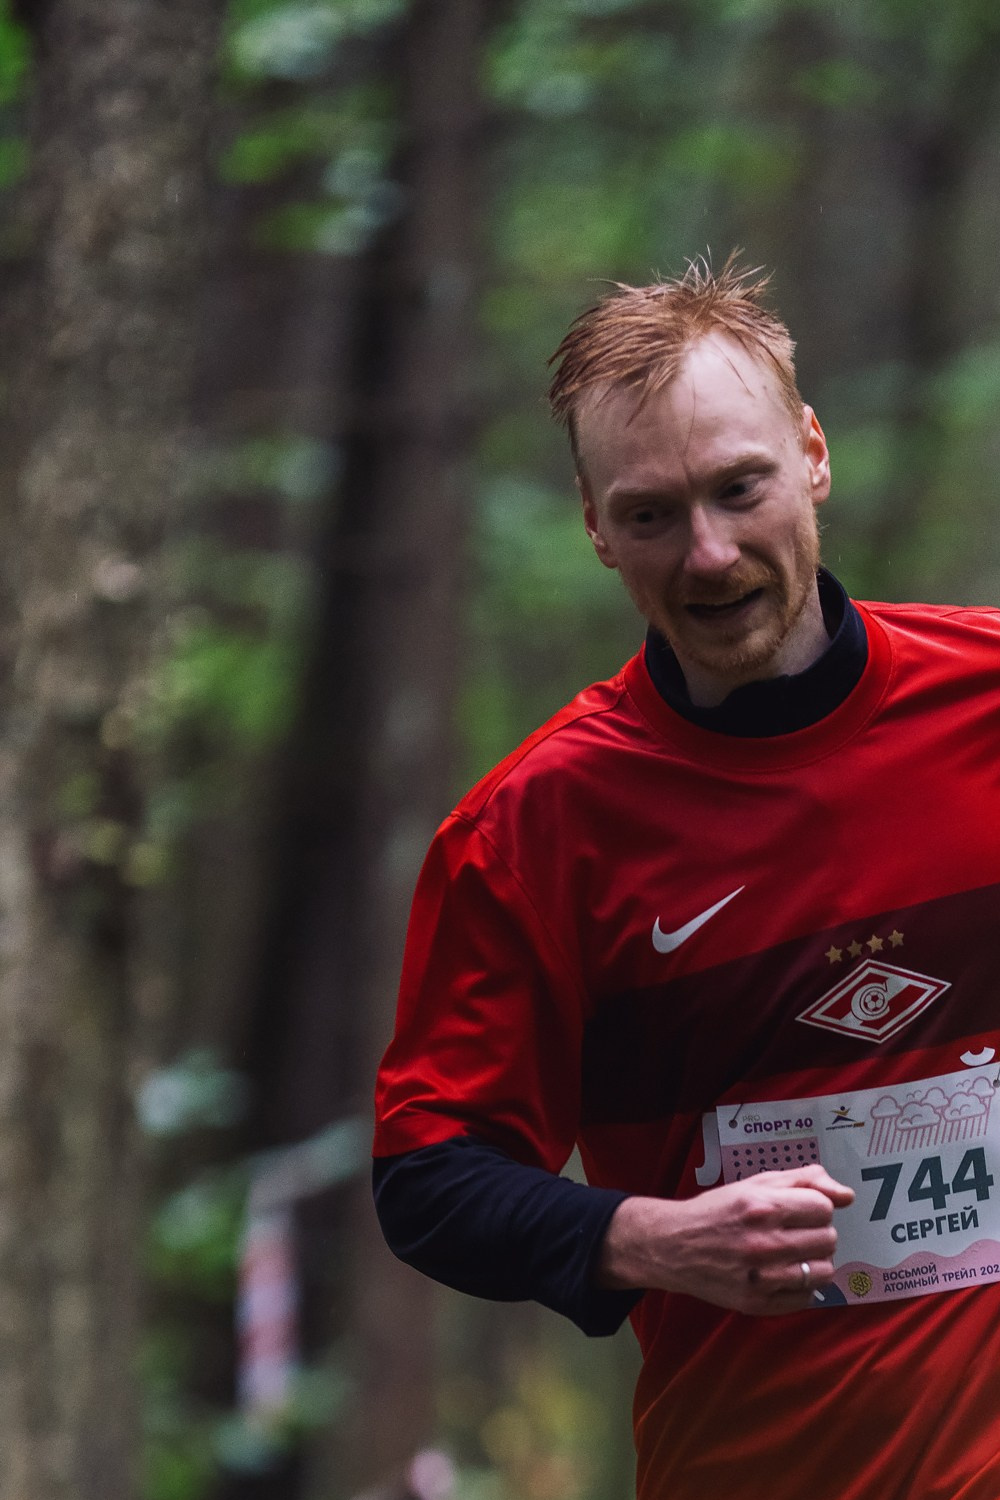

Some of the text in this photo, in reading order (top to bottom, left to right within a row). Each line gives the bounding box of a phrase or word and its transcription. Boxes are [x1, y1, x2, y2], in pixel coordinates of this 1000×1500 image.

[743, 1119, 792, 1134] СПОРТ
[795, 1117, 814, 1129] 40
[861, 1146, 994, 1222] 744
[890, 1205, 979, 1244] СЕРГЕЙ
[883, 1262, 937, 1282] ВОСЬМОЙ
[884, 1274, 939, 1293] АТОМНЫЙ
[942, 1268, 977, 1284] ТРЕЙЛ
